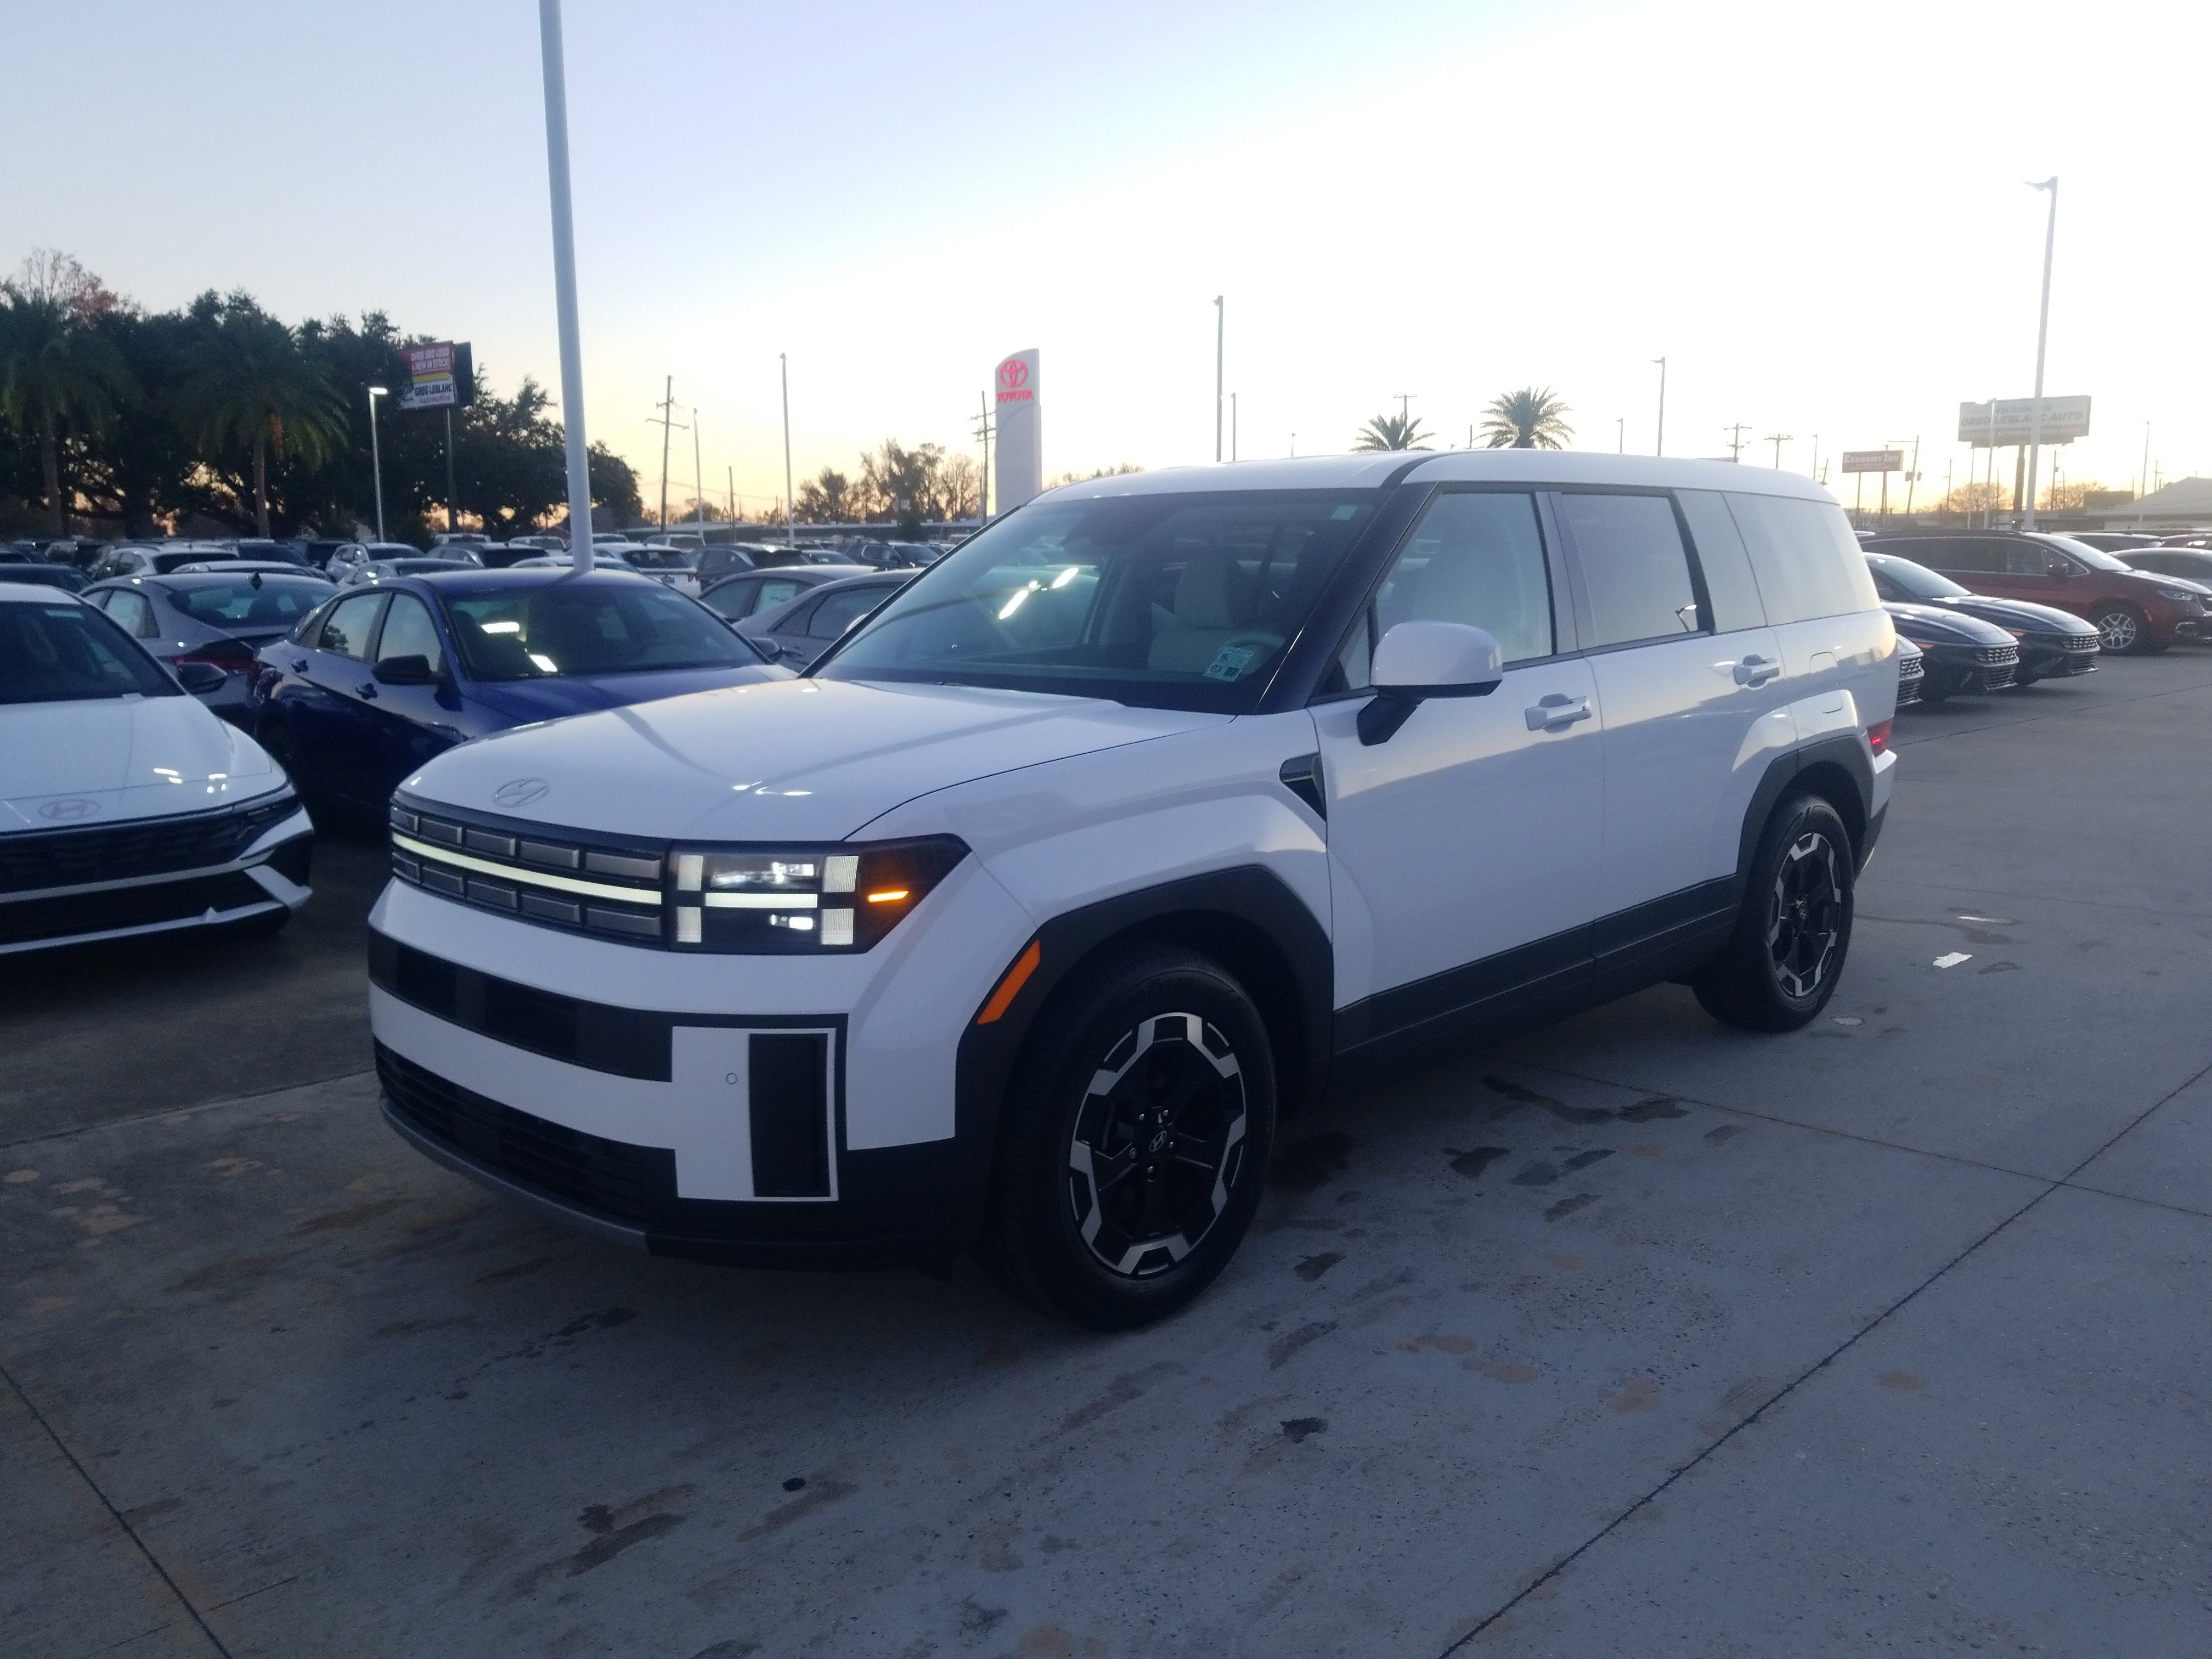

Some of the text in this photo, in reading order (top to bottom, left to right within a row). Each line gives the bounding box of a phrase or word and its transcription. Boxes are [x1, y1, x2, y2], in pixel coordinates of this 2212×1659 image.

[996, 388, 1032, 403] TOYOTA
[1960, 411, 2083, 426] GREG LEBLAC AUTO
[1210, 664, 1223, 673] 03
